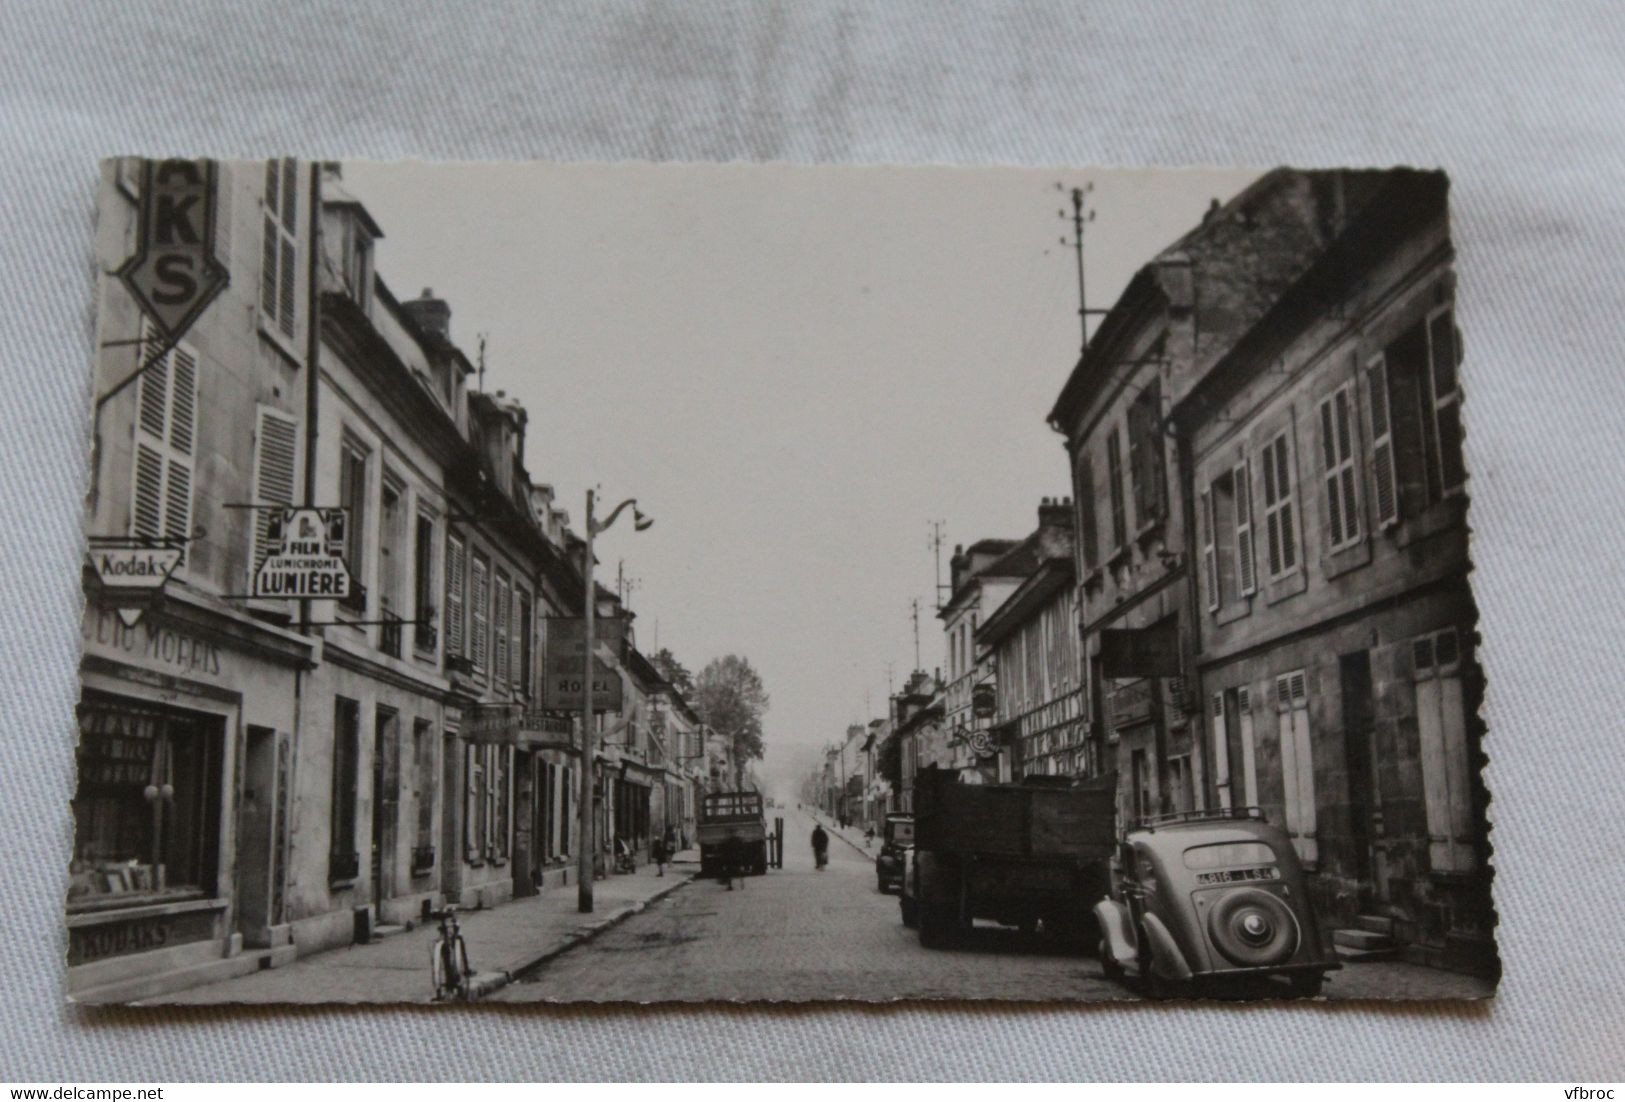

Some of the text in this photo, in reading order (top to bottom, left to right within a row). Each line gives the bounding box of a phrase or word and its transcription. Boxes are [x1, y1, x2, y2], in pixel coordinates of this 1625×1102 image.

[290, 542, 320, 555] FILM
[270, 558, 338, 569] LUMICHROME
[558, 679, 610, 692] HOEL
